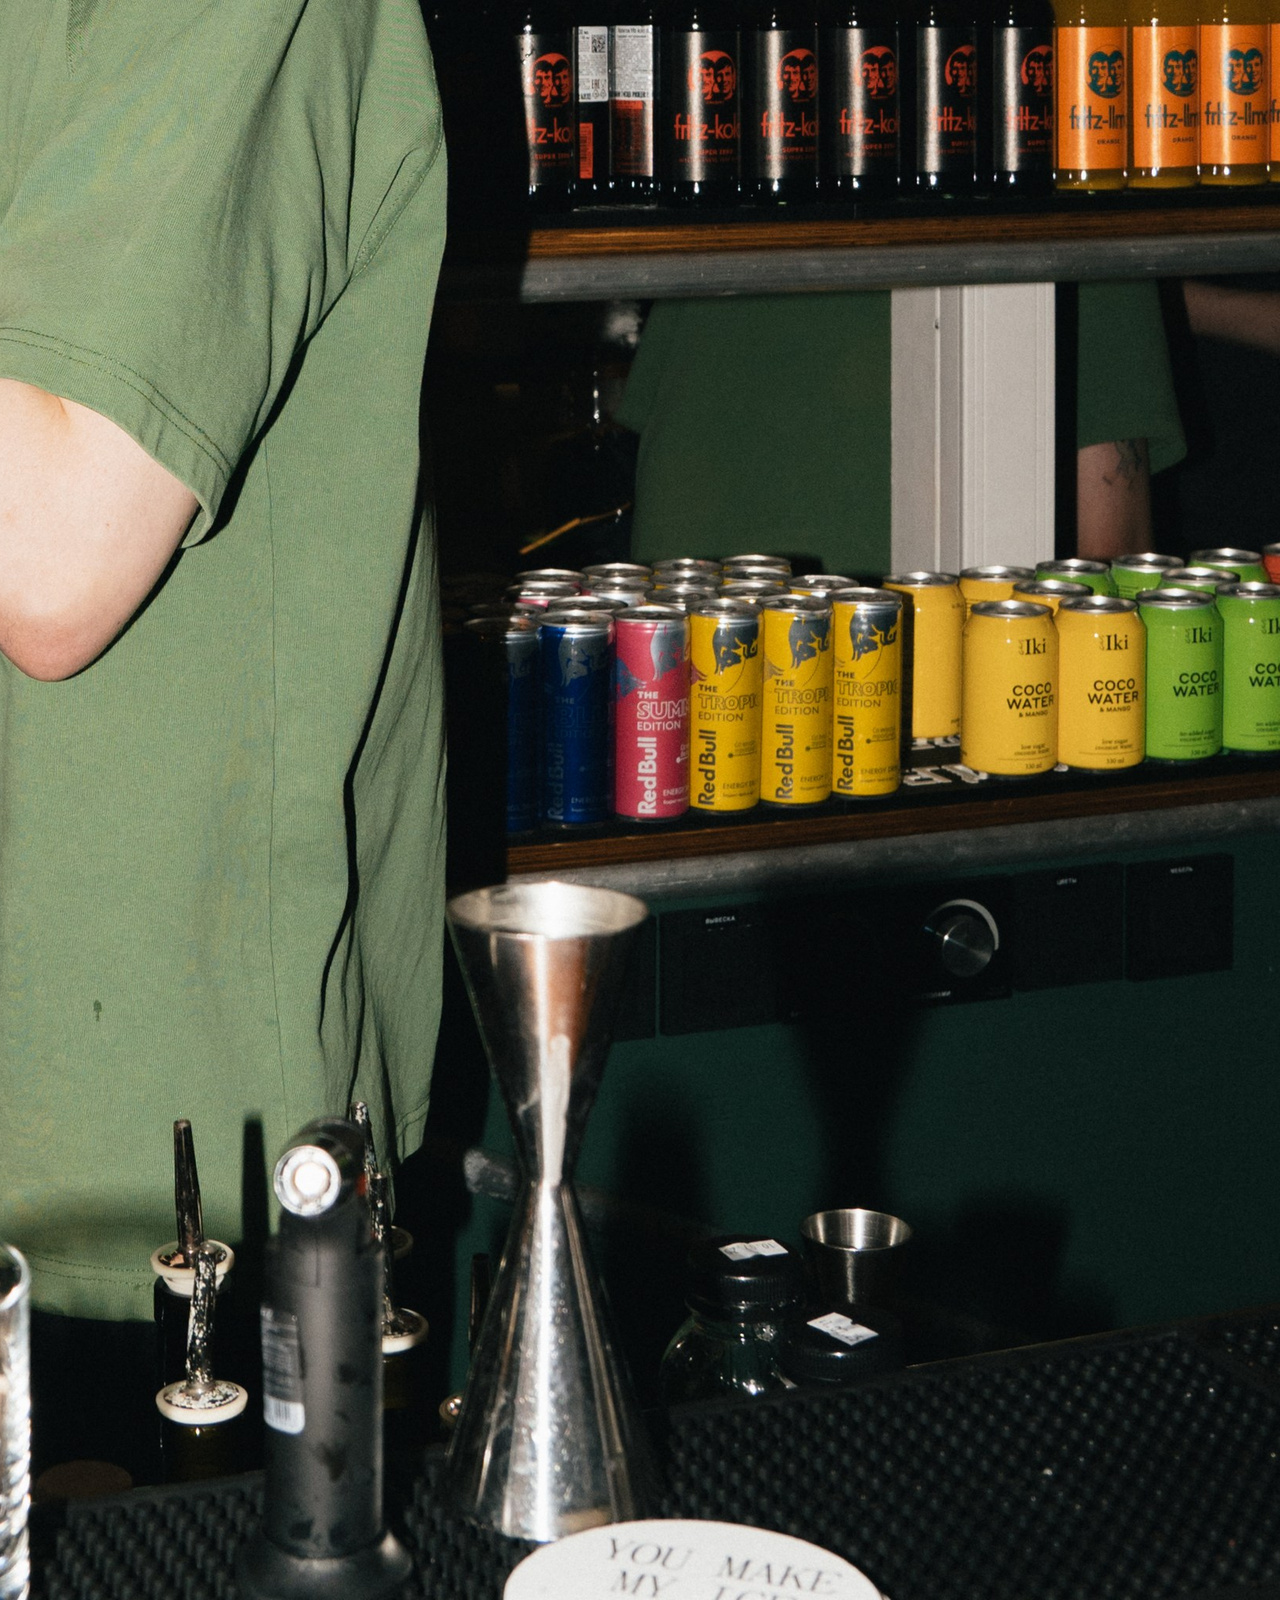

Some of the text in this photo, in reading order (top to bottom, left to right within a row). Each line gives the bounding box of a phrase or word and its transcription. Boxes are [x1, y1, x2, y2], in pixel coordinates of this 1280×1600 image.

[1268, 617, 1280, 635] Ik
[1025, 638, 1046, 655] Iki
[1106, 633, 1129, 651] Iki
[837, 670, 856, 680] THE
[1179, 669, 1217, 685] COCO
[698, 684, 718, 693] THE
[775, 679, 795, 688] THE
[1012, 681, 1052, 697] COCO
[1093, 677, 1136, 692] COCO
[1172, 681, 1220, 698] WATER
[637, 691, 659, 699] THE
[836, 698, 882, 708] EDITION
[1006, 694, 1055, 710] WATER
[1087, 690, 1139, 705] WATER
[698, 712, 744, 722] EDITION
[774, 706, 820, 716] EDITION
[1025, 709, 1049, 718] MANGO
[1106, 705, 1131, 713] MANGO
[637, 720, 681, 732] EDITION
[837, 715, 855, 791] Red Bull
[698, 729, 717, 805] Red Bull
[775, 723, 794, 800] Red Bull
[637, 736, 657, 814] Red Bull
[609, 1538, 842, 1595] YOU MAKE
[612, 1570, 677, 1598] MY
